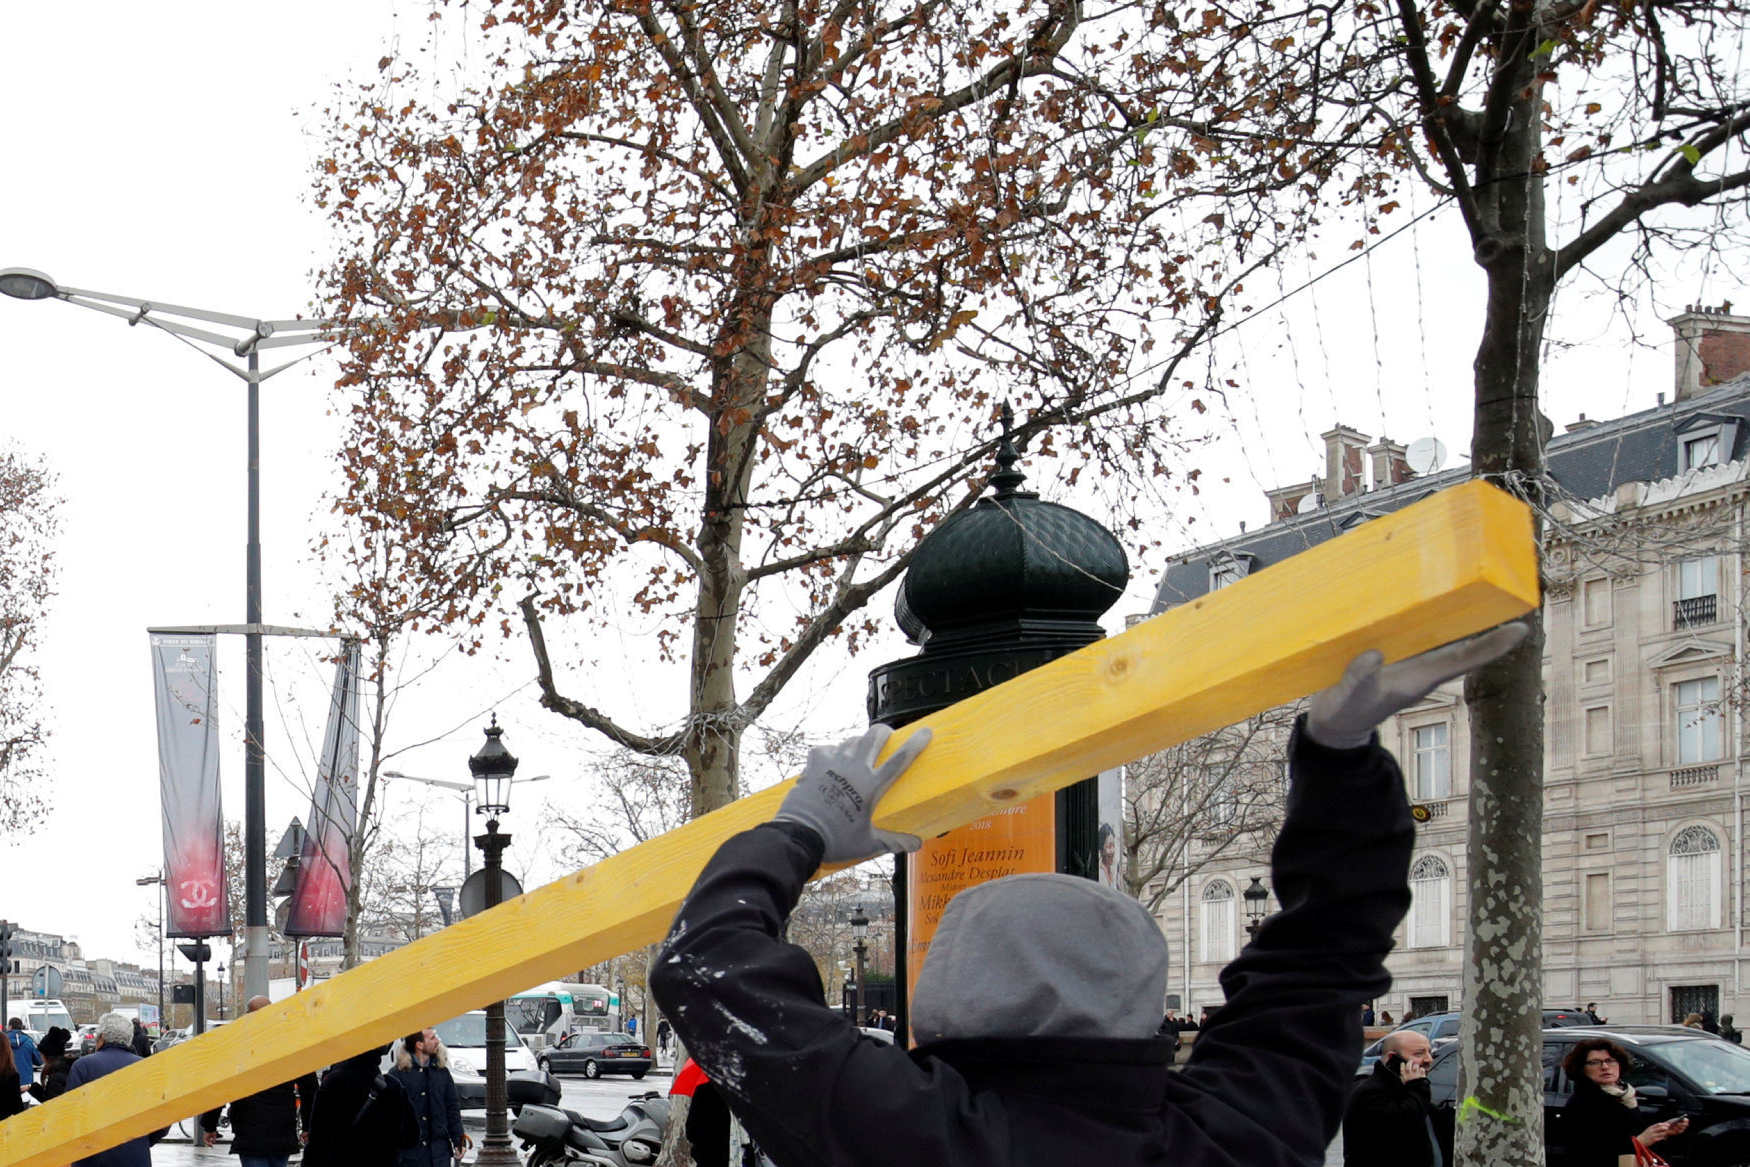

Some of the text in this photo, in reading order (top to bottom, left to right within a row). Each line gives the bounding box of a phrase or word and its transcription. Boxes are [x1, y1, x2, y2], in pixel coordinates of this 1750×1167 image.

[969, 820, 993, 831] 2018
[930, 846, 1025, 869] Sofi Jeannin
